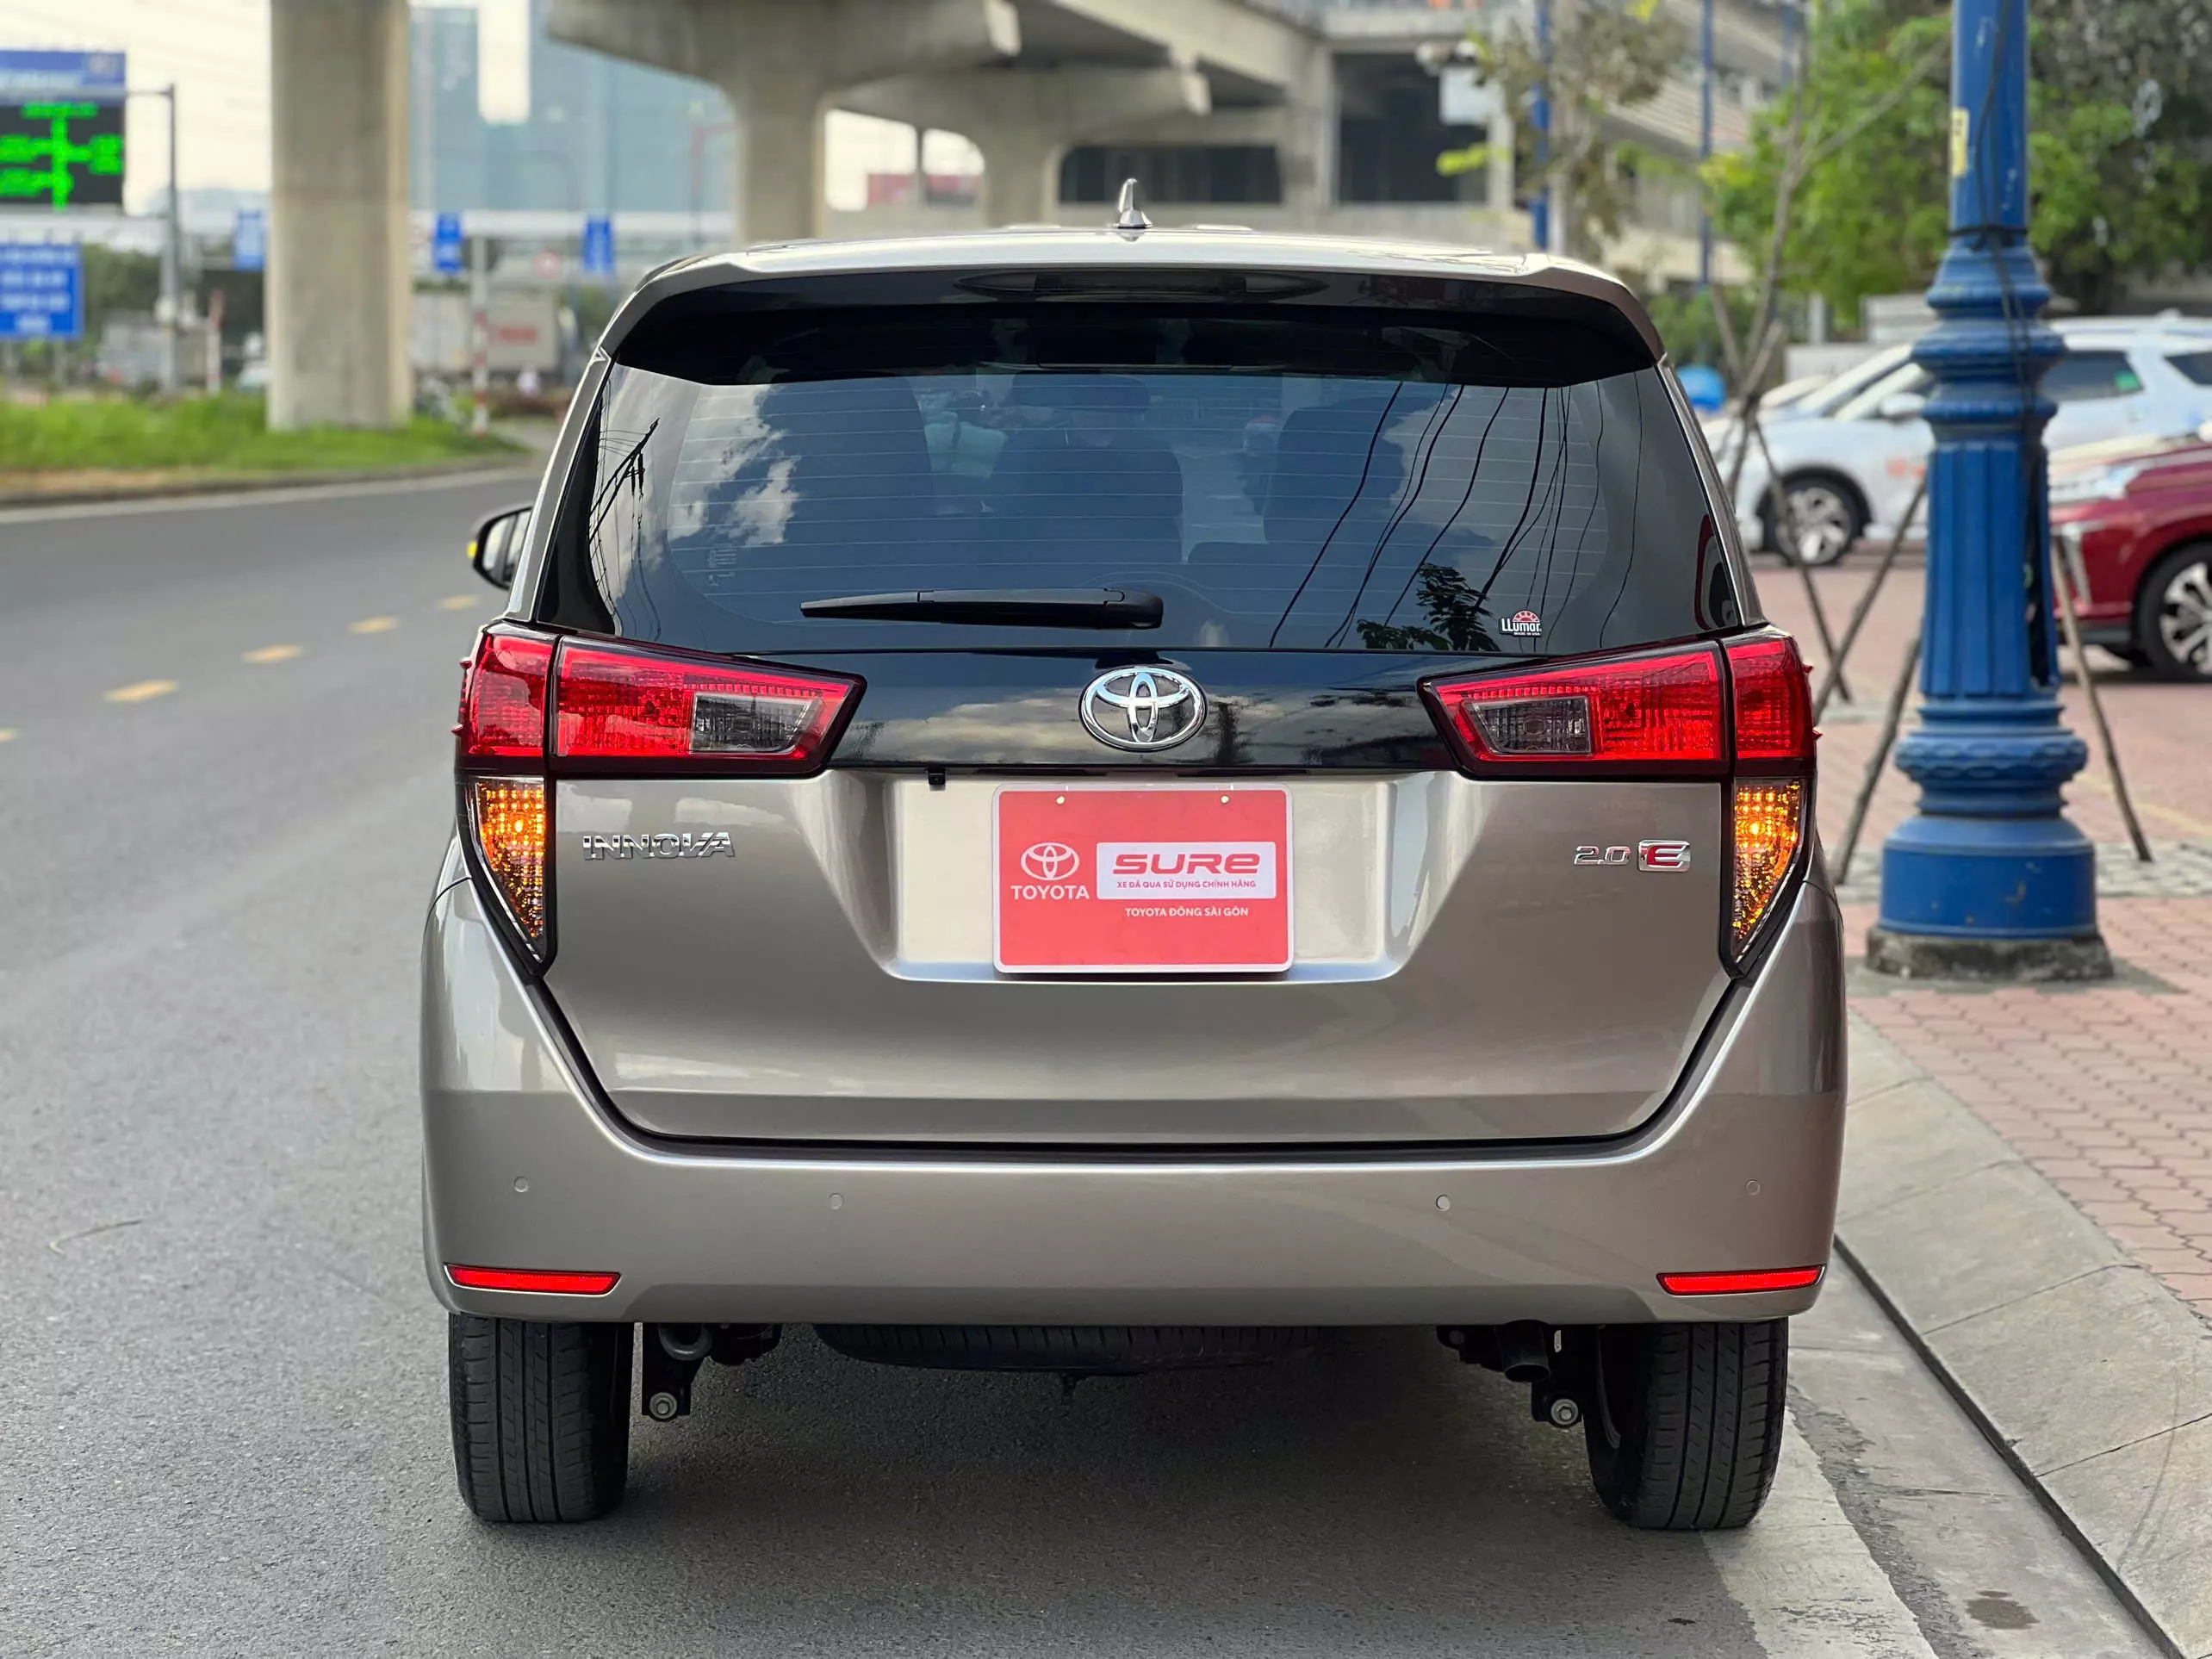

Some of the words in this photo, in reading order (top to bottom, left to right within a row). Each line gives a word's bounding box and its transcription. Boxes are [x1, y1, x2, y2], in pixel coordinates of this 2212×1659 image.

[1501, 618, 1541, 631] LLumar
[582, 832, 736, 860] INNOVA
[1574, 846, 1631, 865] 2.0
[1175, 880, 1201, 890] DỤNG
[1202, 879, 1229, 888] CHÍNH
[1010, 885, 1090, 900] TOYOTA
[1124, 907, 1167, 917] TOYOTA
[1168, 905, 1202, 917] ĐÔNG
[1203, 904, 1221, 917] SÀI
[1223, 904, 1249, 917] GÒN
